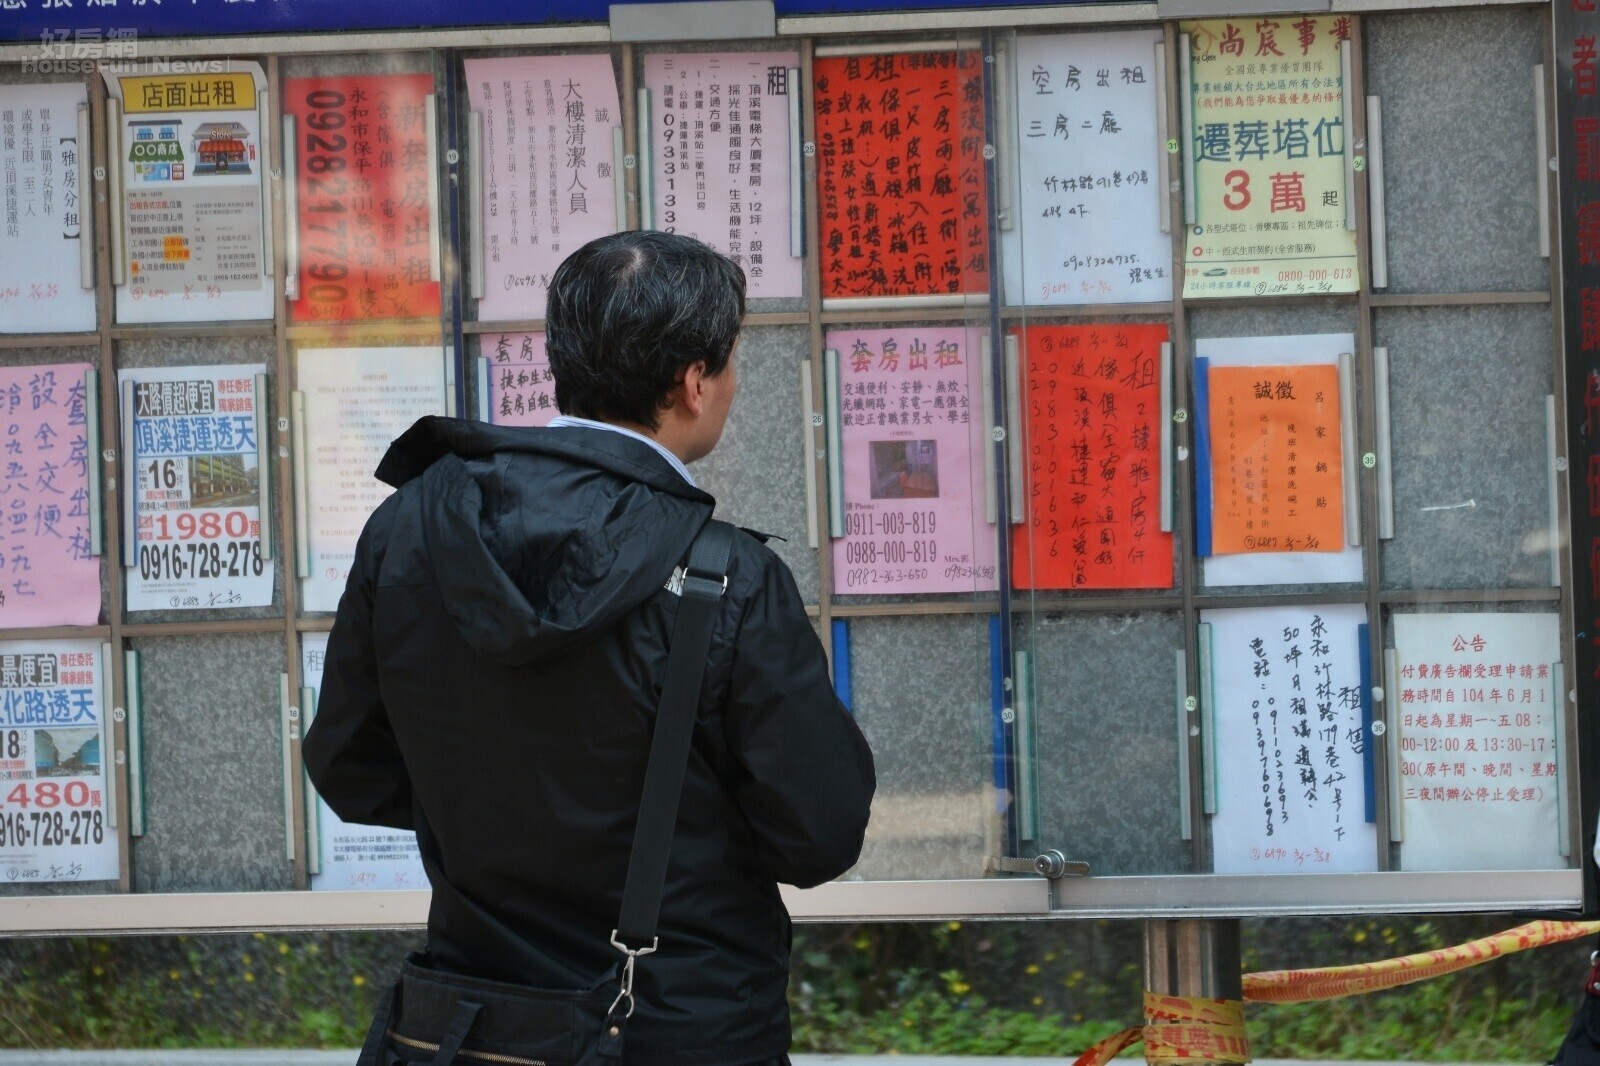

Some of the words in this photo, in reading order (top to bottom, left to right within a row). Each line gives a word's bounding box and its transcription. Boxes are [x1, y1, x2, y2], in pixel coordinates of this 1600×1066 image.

[1225, 61, 1325, 76] 全國最專業優質團隊
[767, 65, 788, 96] 租
[1032, 65, 1147, 95] 空房出租
[142, 80, 237, 108] 店面出租
[210, 129, 233, 140] Store
[1027, 110, 1122, 141] 三房二廳
[561, 78, 588, 215] 大樓清潔人員
[594, 107, 612, 179] 誠徵
[1168, 142, 1178, 150] 31
[1194, 116, 1344, 163] 遷葬塔位
[448, 153, 458, 161] 19
[804, 144, 815, 155] 25
[625, 157, 635, 166] 22
[305, 90, 349, 304] 0928217790
[394, 103, 431, 286] 新套房出租
[1223, 169, 1252, 211] 3
[1268, 171, 1307, 213] 萬
[1322, 190, 1339, 207] 起
[1278, 268, 1352, 282] 0800-000-613
[495, 334, 549, 363] 套房
[849, 337, 963, 373] 套房出租
[217, 378, 252, 393] 專任委託
[1253, 380, 1297, 401] 誠徵
[137, 380, 215, 417] 大降價超便宜
[218, 398, 253, 413] 獨家銷售
[278, 420, 286, 429] 17
[813, 415, 823, 424] 26
[842, 411, 970, 427] 歡迎正當職業男女、學生
[135, 415, 257, 455] 頂溪捷運透天
[993, 428, 1003, 439] 29
[1315, 392, 1328, 508] 呂家鍋貼
[63, 379, 93, 561] 套房出租
[1364, 456, 1376, 465] 35
[148, 459, 177, 489] 16
[1286, 424, 1298, 517] 晚班清潔洗碗工
[155, 510, 249, 542] 1980
[845, 511, 937, 536] 0911-003-819
[139, 541, 264, 581] 0916-728-278
[846, 540, 937, 564] 0988-000-819
[1452, 634, 1487, 652] 公告
[60, 652, 93, 667] 專任委託
[60, 671, 94, 686] 獨家銷售
[1401, 663, 1549, 679] 付費廣告欄受理申請業
[1402, 689, 1455, 704] 務時間自
[1462, 689, 1485, 702] 104
[1507, 689, 1515, 702] 6
[0, 689, 96, 725] 化路透天
[114, 711, 123, 719] 15
[289, 710, 298, 718] 18
[1004, 711, 1013, 720] 30
[1373, 724, 1383, 733] 36
[1464, 738, 1478, 752] 及
